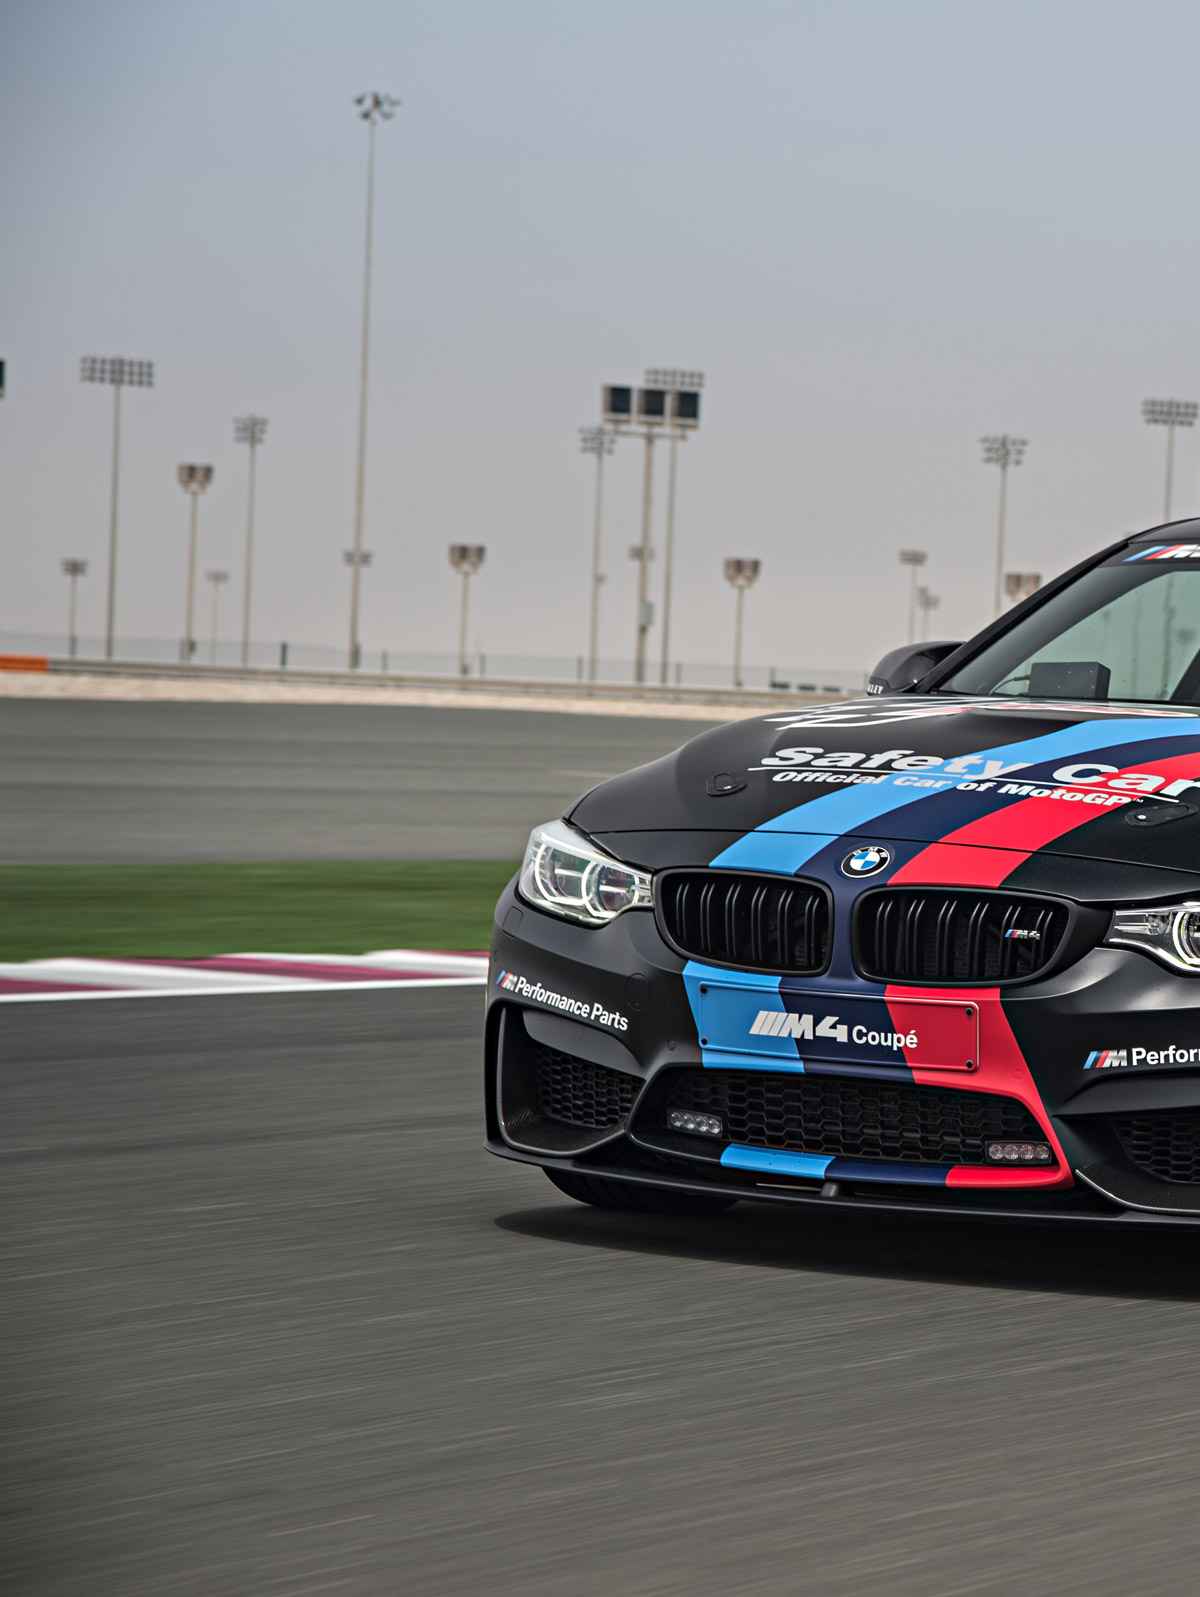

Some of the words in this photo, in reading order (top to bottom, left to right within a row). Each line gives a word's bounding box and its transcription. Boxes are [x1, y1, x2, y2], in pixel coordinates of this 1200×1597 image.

[760, 747, 1035, 781] Safety
[771, 771, 886, 785] Official
[892, 776, 952, 789] Car
[955, 781, 998, 793] of
[514, 976, 590, 1018] Performance
[590, 1002, 629, 1032] Parts
[852, 1024, 918, 1051] Coupé
